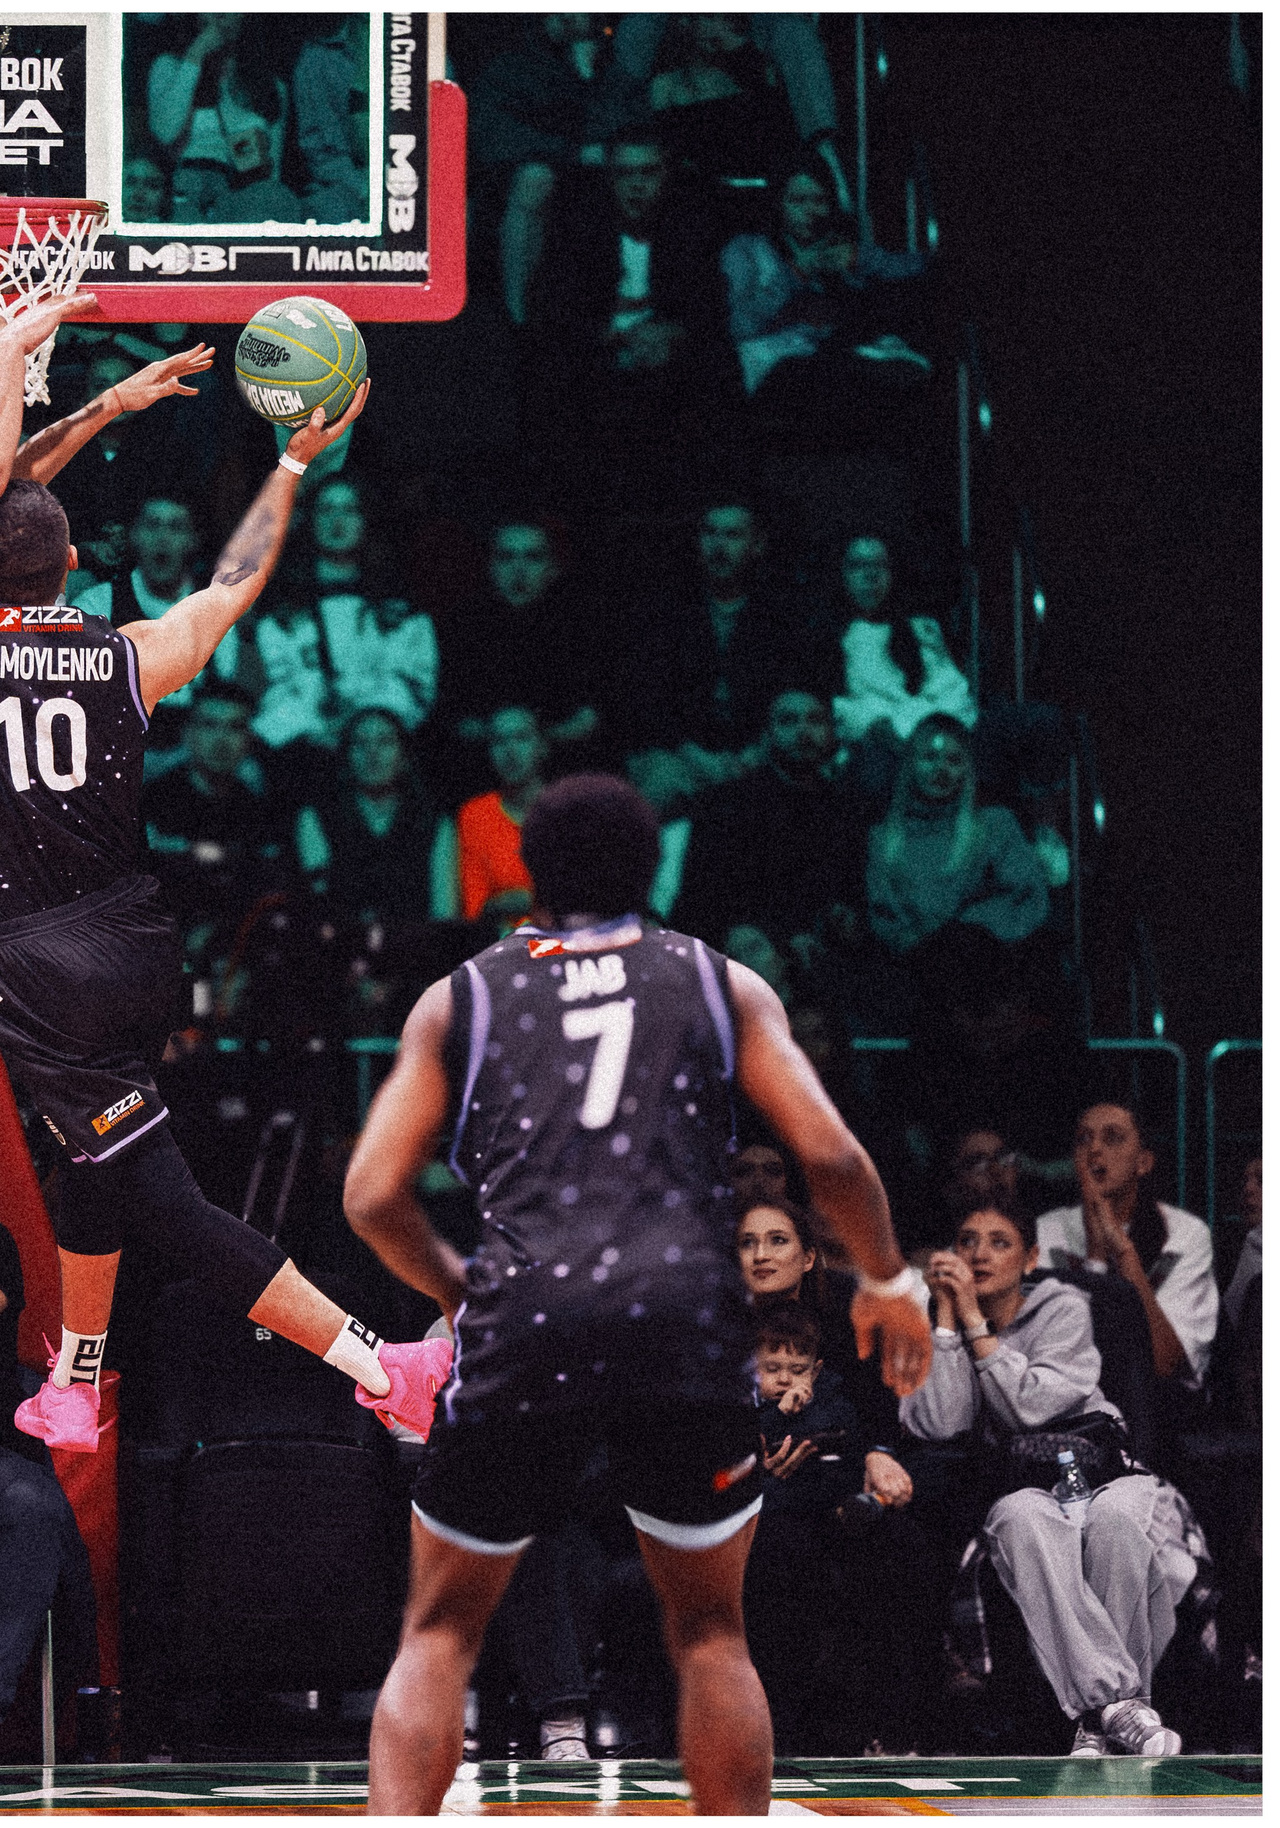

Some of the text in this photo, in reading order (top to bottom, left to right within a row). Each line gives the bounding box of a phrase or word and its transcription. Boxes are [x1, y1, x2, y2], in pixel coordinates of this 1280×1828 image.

[258, 386, 306, 417] MEDIA
[22, 623, 84, 634] VITAMIN DRINK
[561, 999, 635, 1129] 7
[256, 1328, 272, 1341] 65
